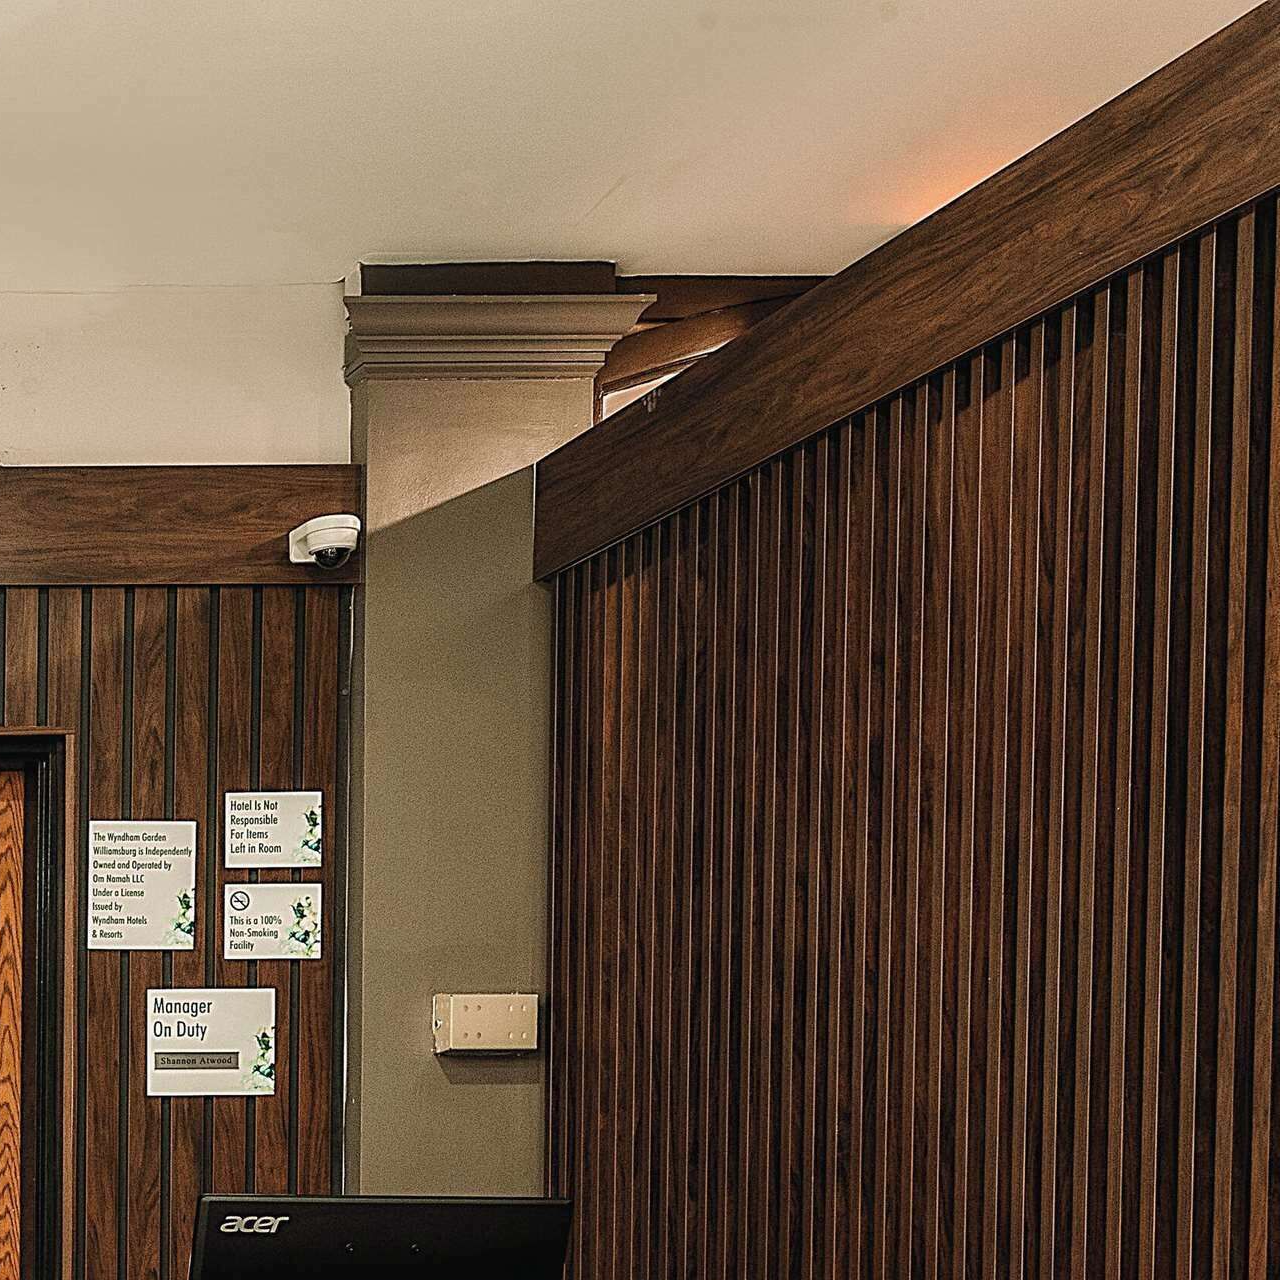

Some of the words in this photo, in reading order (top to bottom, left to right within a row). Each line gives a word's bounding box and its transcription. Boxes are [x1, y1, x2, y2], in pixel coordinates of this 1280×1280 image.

[230, 800, 252, 811] Hotel
[254, 800, 261, 811] Is
[263, 800, 278, 811] Not
[230, 814, 279, 827] Responsible
[93, 832, 106, 842] The
[107, 832, 141, 843] Wyndham
[142, 832, 167, 842] Garden
[230, 829, 244, 839] For
[246, 829, 269, 839] Items
[93, 846, 137, 857] Williamsburg
[138, 846, 144, 855] is
[145, 846, 193, 857] Independently
[230, 843, 246, 854] Left
[248, 843, 256, 853] in
[258, 842, 282, 853] Room
[92, 860, 116, 869] Owned
[117, 860, 131, 869] and
[131, 860, 162, 870] Operated
[163, 860, 172, 871] by
[92, 874, 105, 883] Om
[106, 874, 131, 883] Namah
[132, 874, 145, 883] LLC
[92, 888, 113, 897] Under
[120, 888, 145, 897] License
[92, 902, 113, 910] Issued
[114, 902, 123, 912] by
[91, 916, 125, 926] Wyndham
[126, 916, 148, 924] Hotels
[230, 916, 244, 925] This
[245, 916, 252, 925] is
[260, 916, 283, 925] 100%
[91, 930, 97, 938] &
[99, 930, 123, 938] Resorts
[229, 928, 279, 939] Non-Smoking
[229, 941, 255, 951] Facility
[153, 997, 213, 1018] Manager
[153, 1020, 172, 1037] On
[176, 1020, 207, 1041] Duty
[160, 1057, 197, 1065] Shannon
[199, 1056, 232, 1065] Atwood
[220, 1215, 289, 1233] acer
